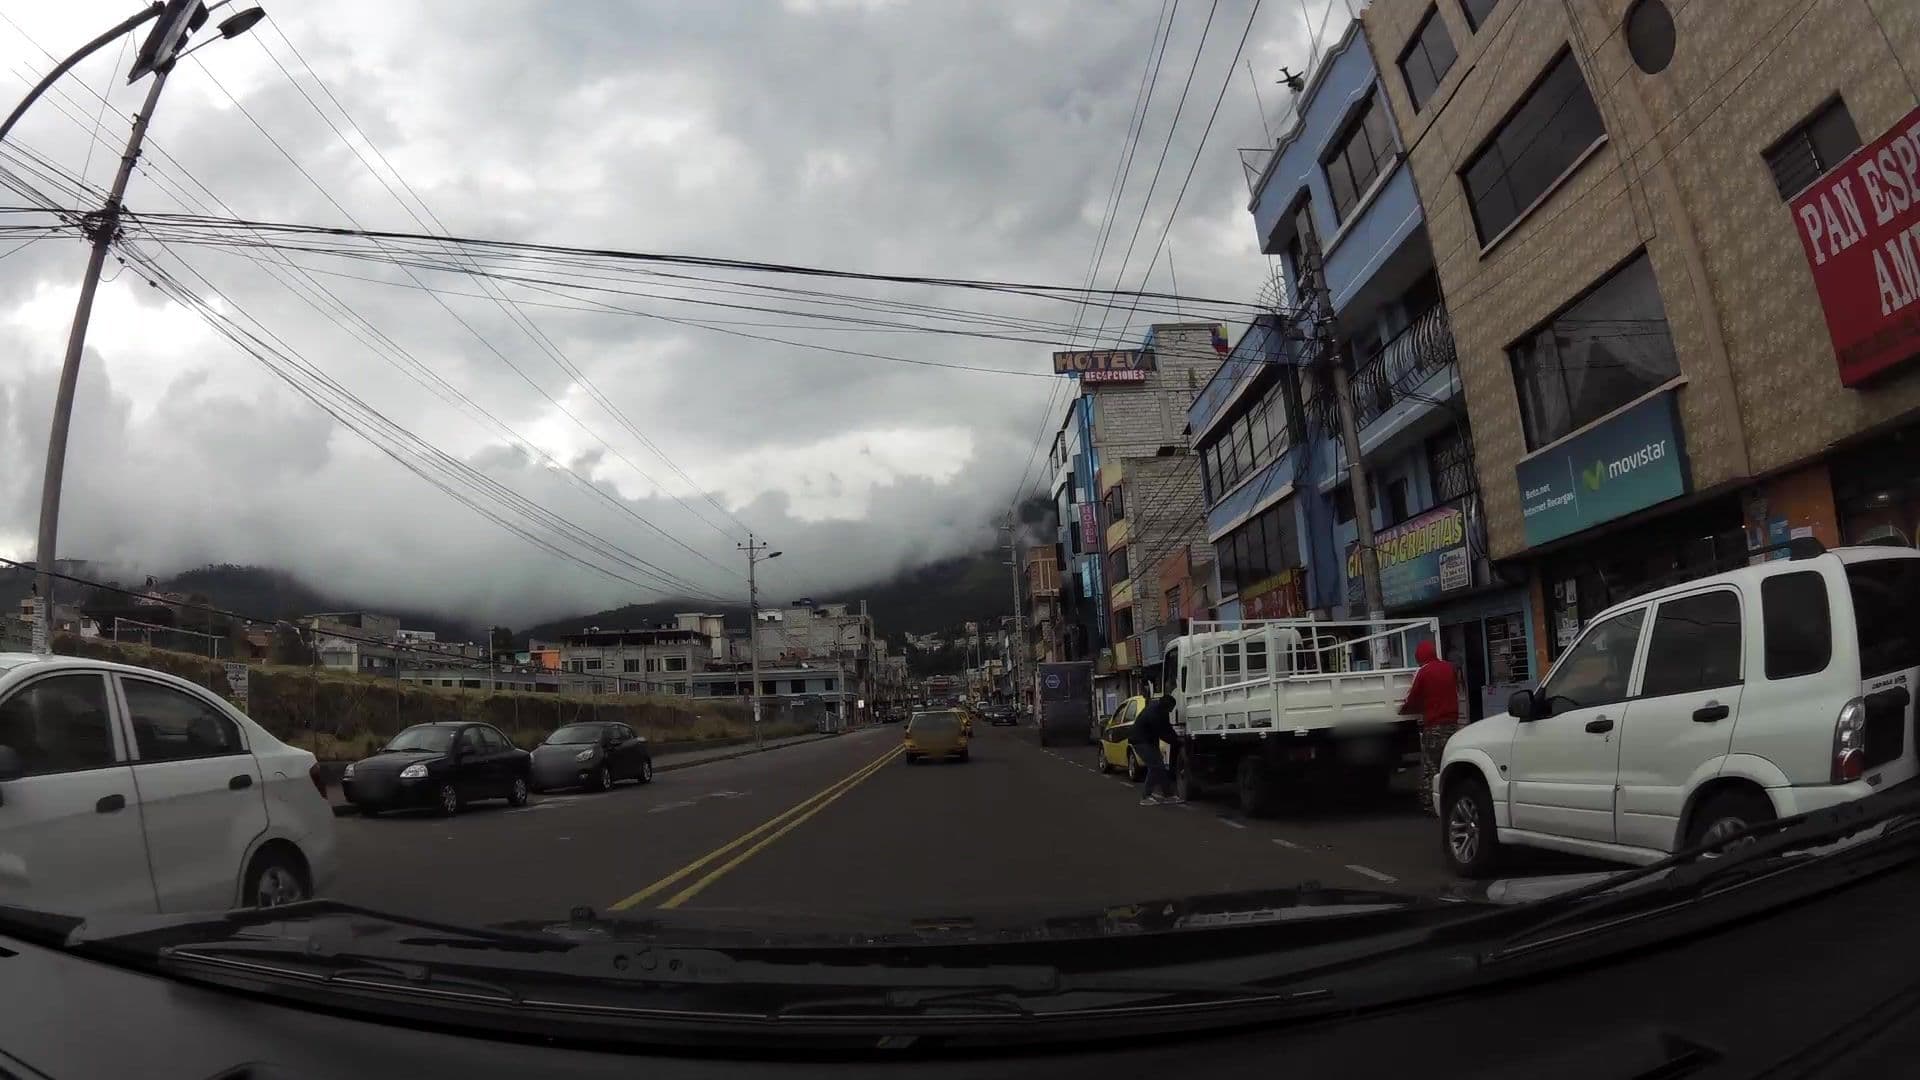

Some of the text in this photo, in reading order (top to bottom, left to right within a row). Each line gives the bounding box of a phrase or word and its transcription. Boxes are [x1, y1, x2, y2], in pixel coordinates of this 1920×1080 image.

[1799, 176, 1868, 265] PAN
[1872, 222, 1920, 316] AM
[1608, 439, 1666, 479] movistar
